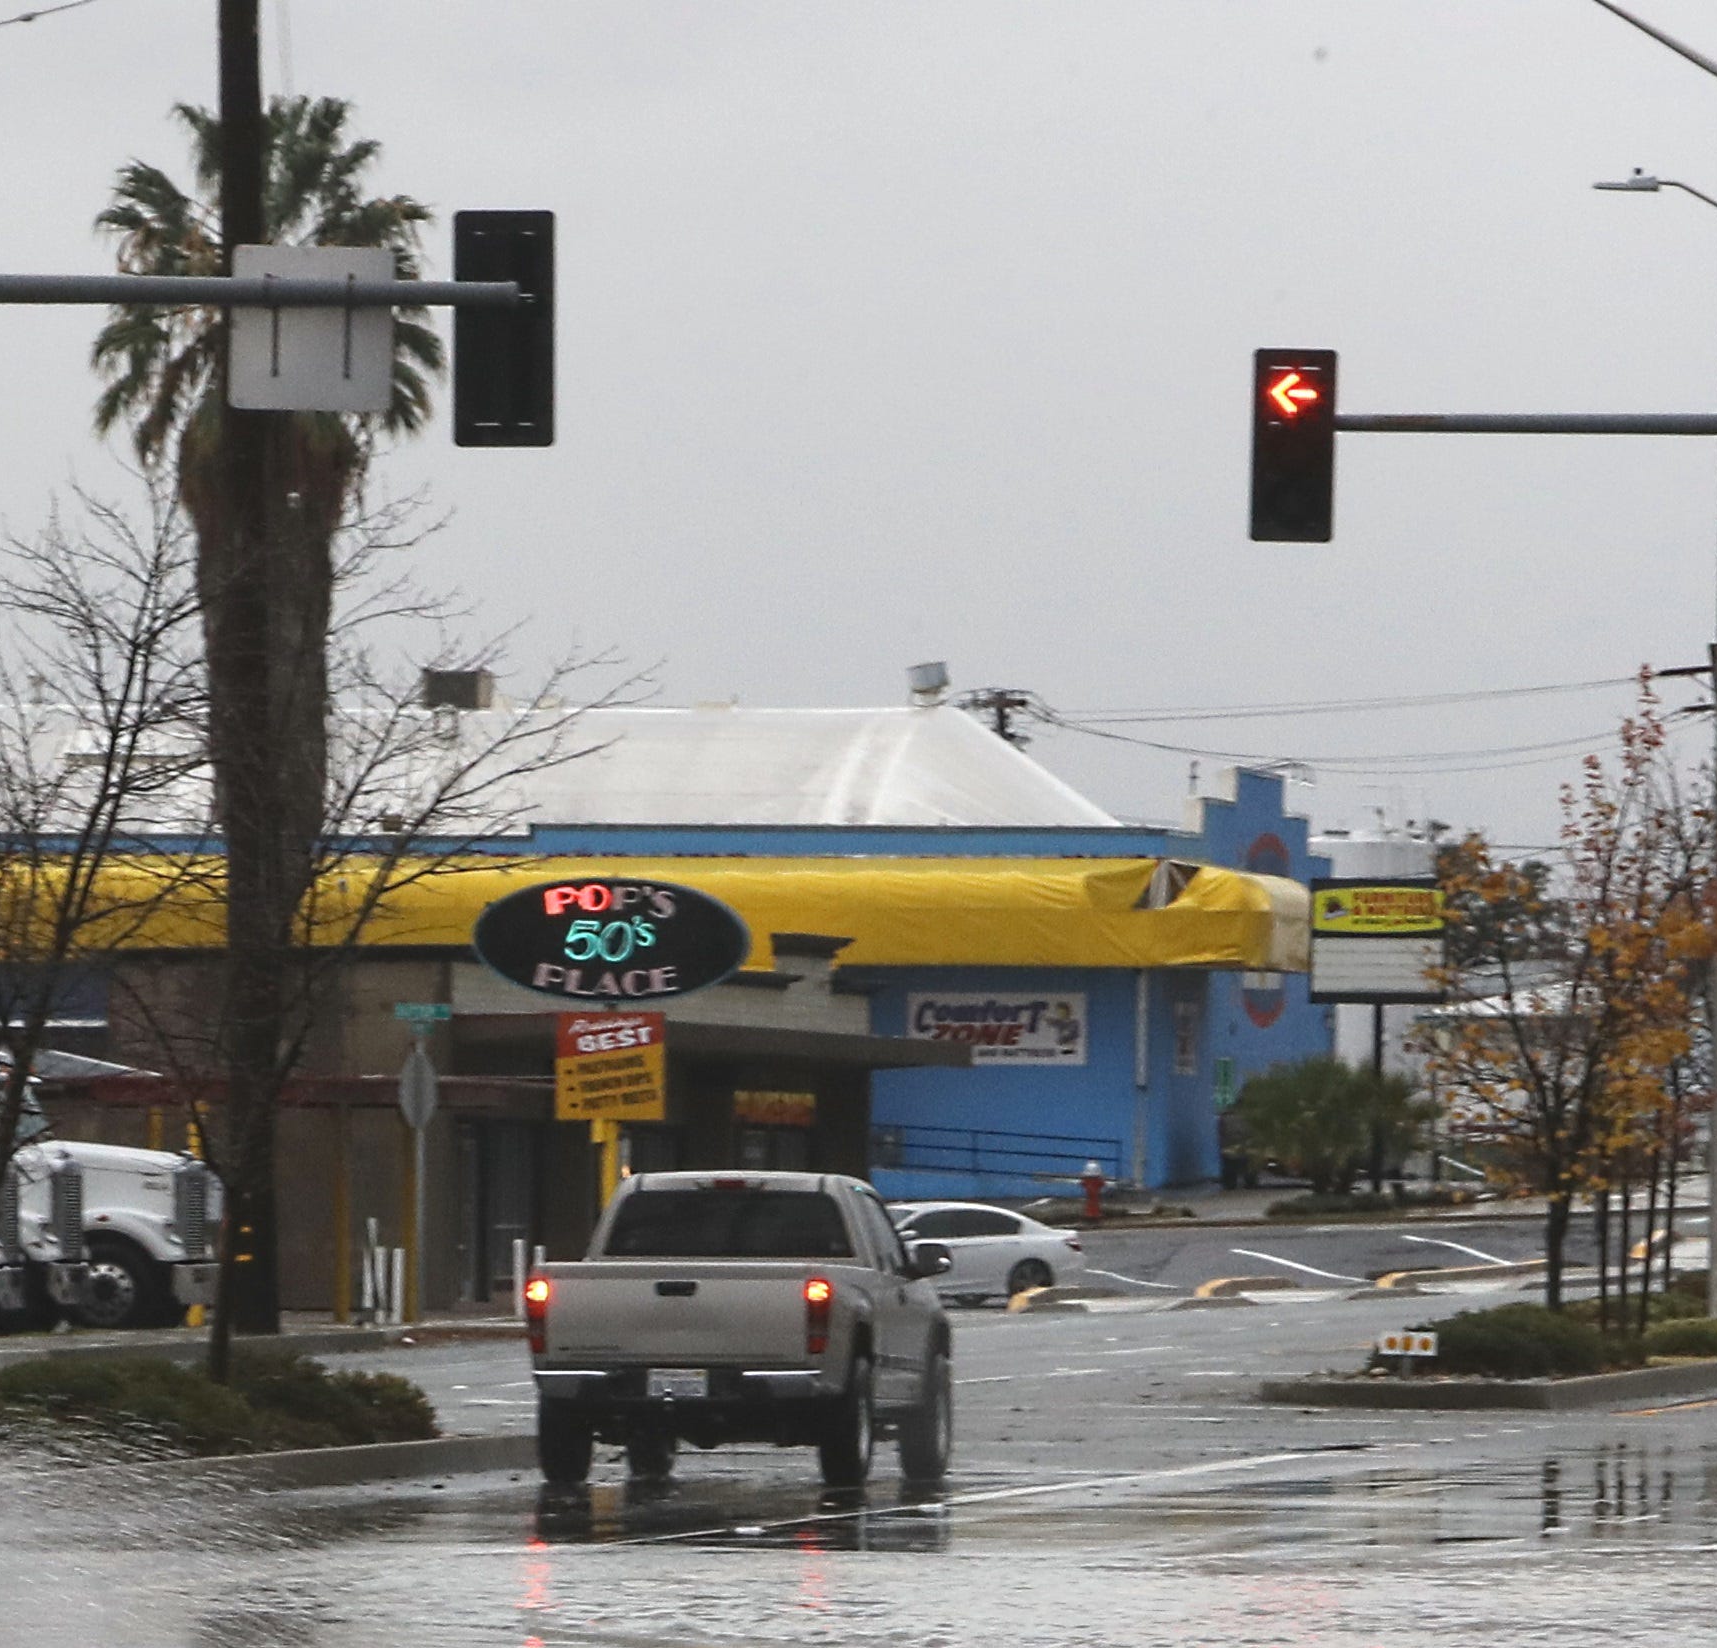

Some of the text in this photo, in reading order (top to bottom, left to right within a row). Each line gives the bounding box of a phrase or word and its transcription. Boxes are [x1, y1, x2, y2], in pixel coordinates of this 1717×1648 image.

[543, 884, 677, 919] POP'S
[564, 915, 657, 962] 50's
[533, 963, 680, 996] PLACE
[576, 1026, 653, 1053] BEST
[931, 1023, 1025, 1046] ZONE
